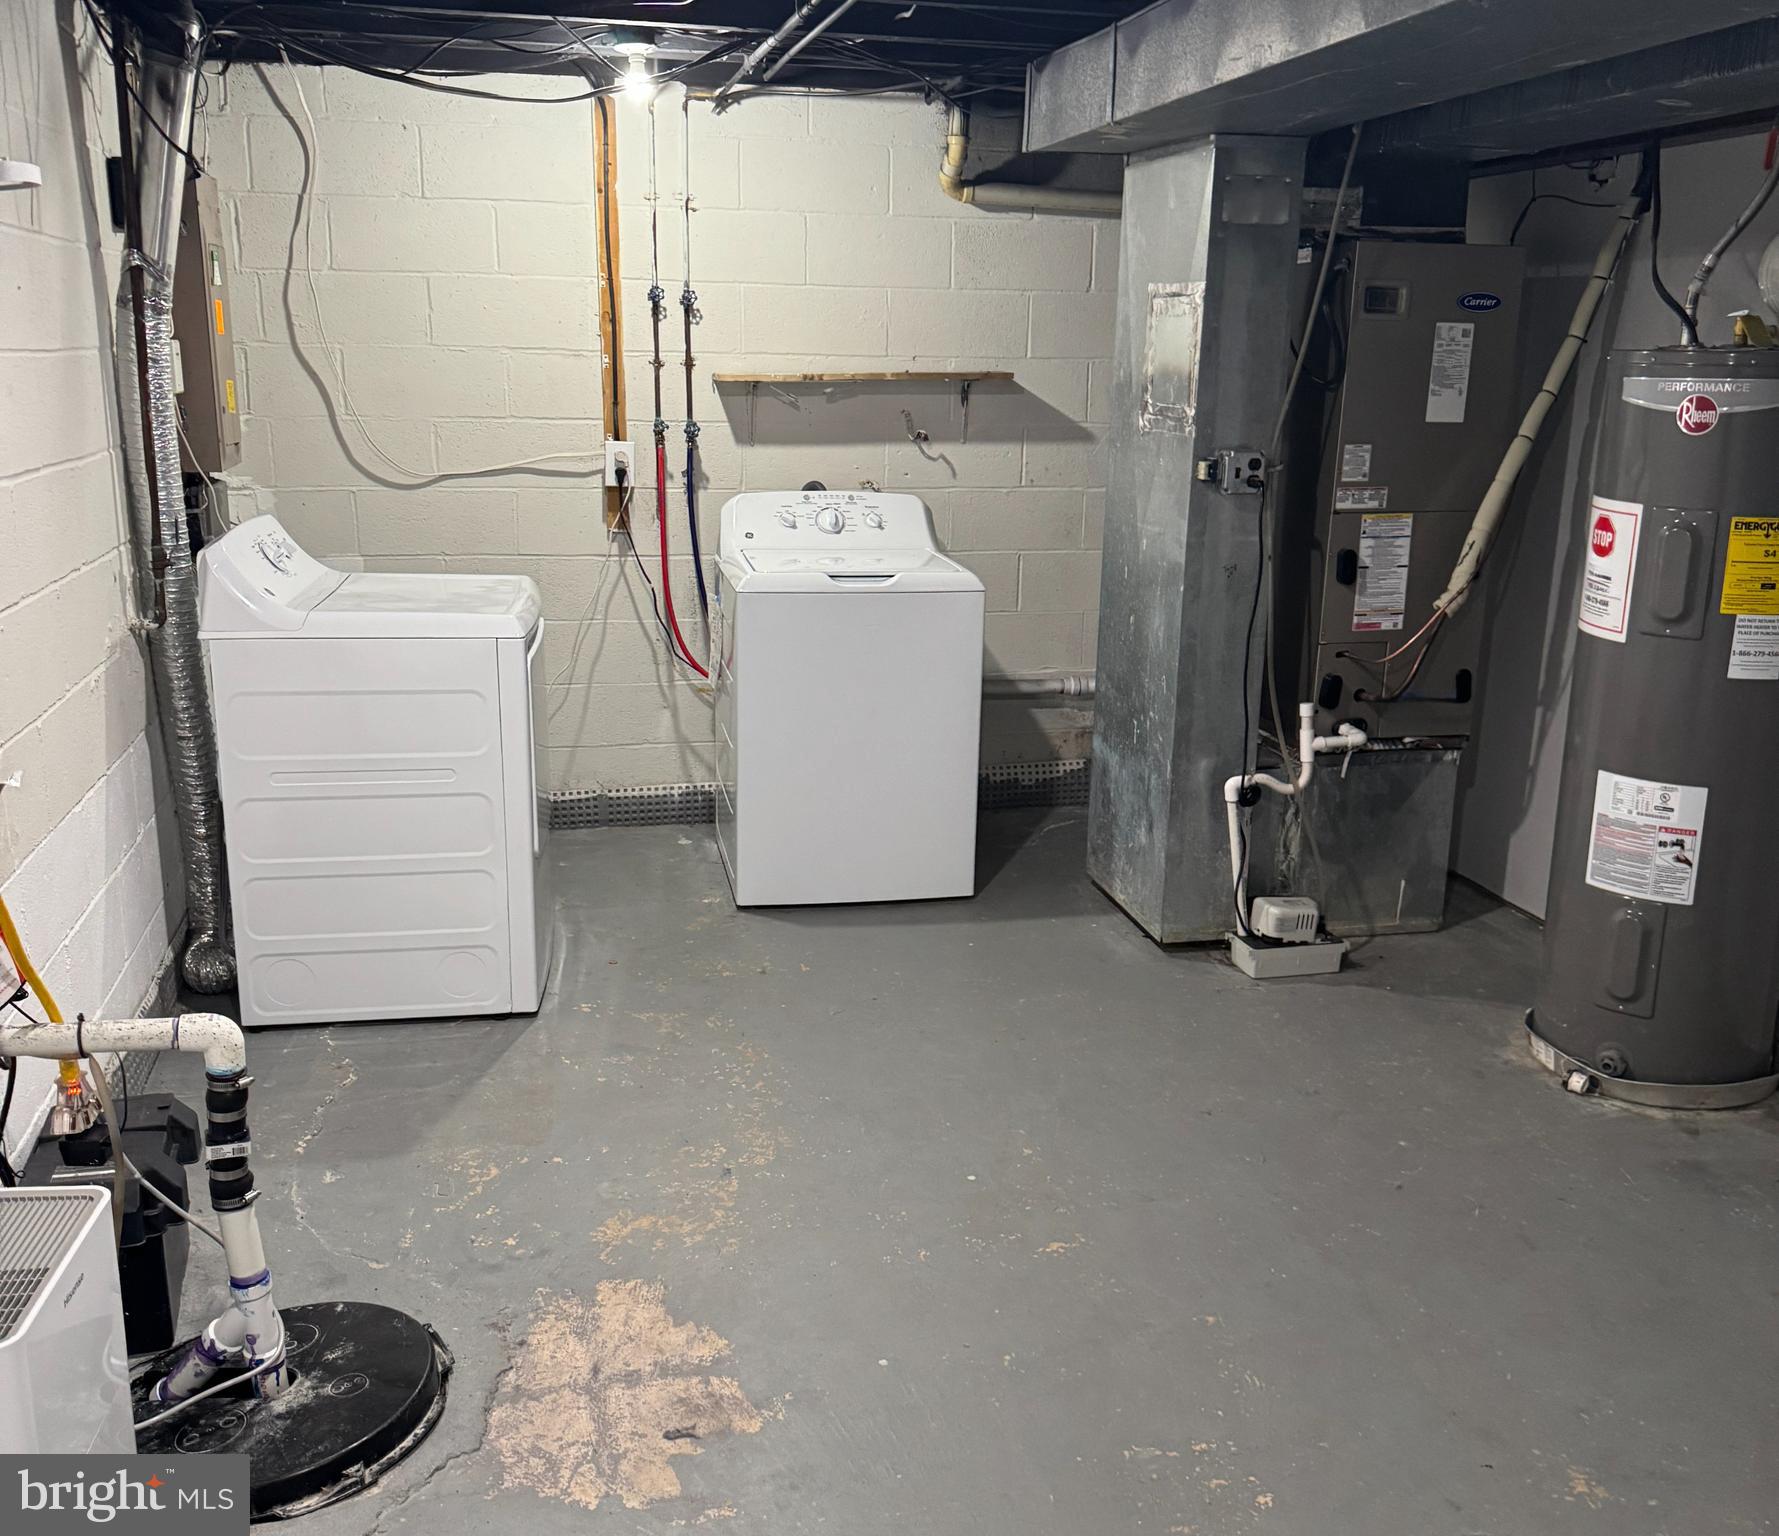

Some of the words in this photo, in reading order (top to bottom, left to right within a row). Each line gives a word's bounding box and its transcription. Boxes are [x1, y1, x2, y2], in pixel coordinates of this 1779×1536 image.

[1463, 296, 1498, 306] Carrier
[1656, 381, 1751, 393] PERFORMANCE
[1680, 396, 1716, 429] Rheem
[1592, 528, 1613, 548] STOP
